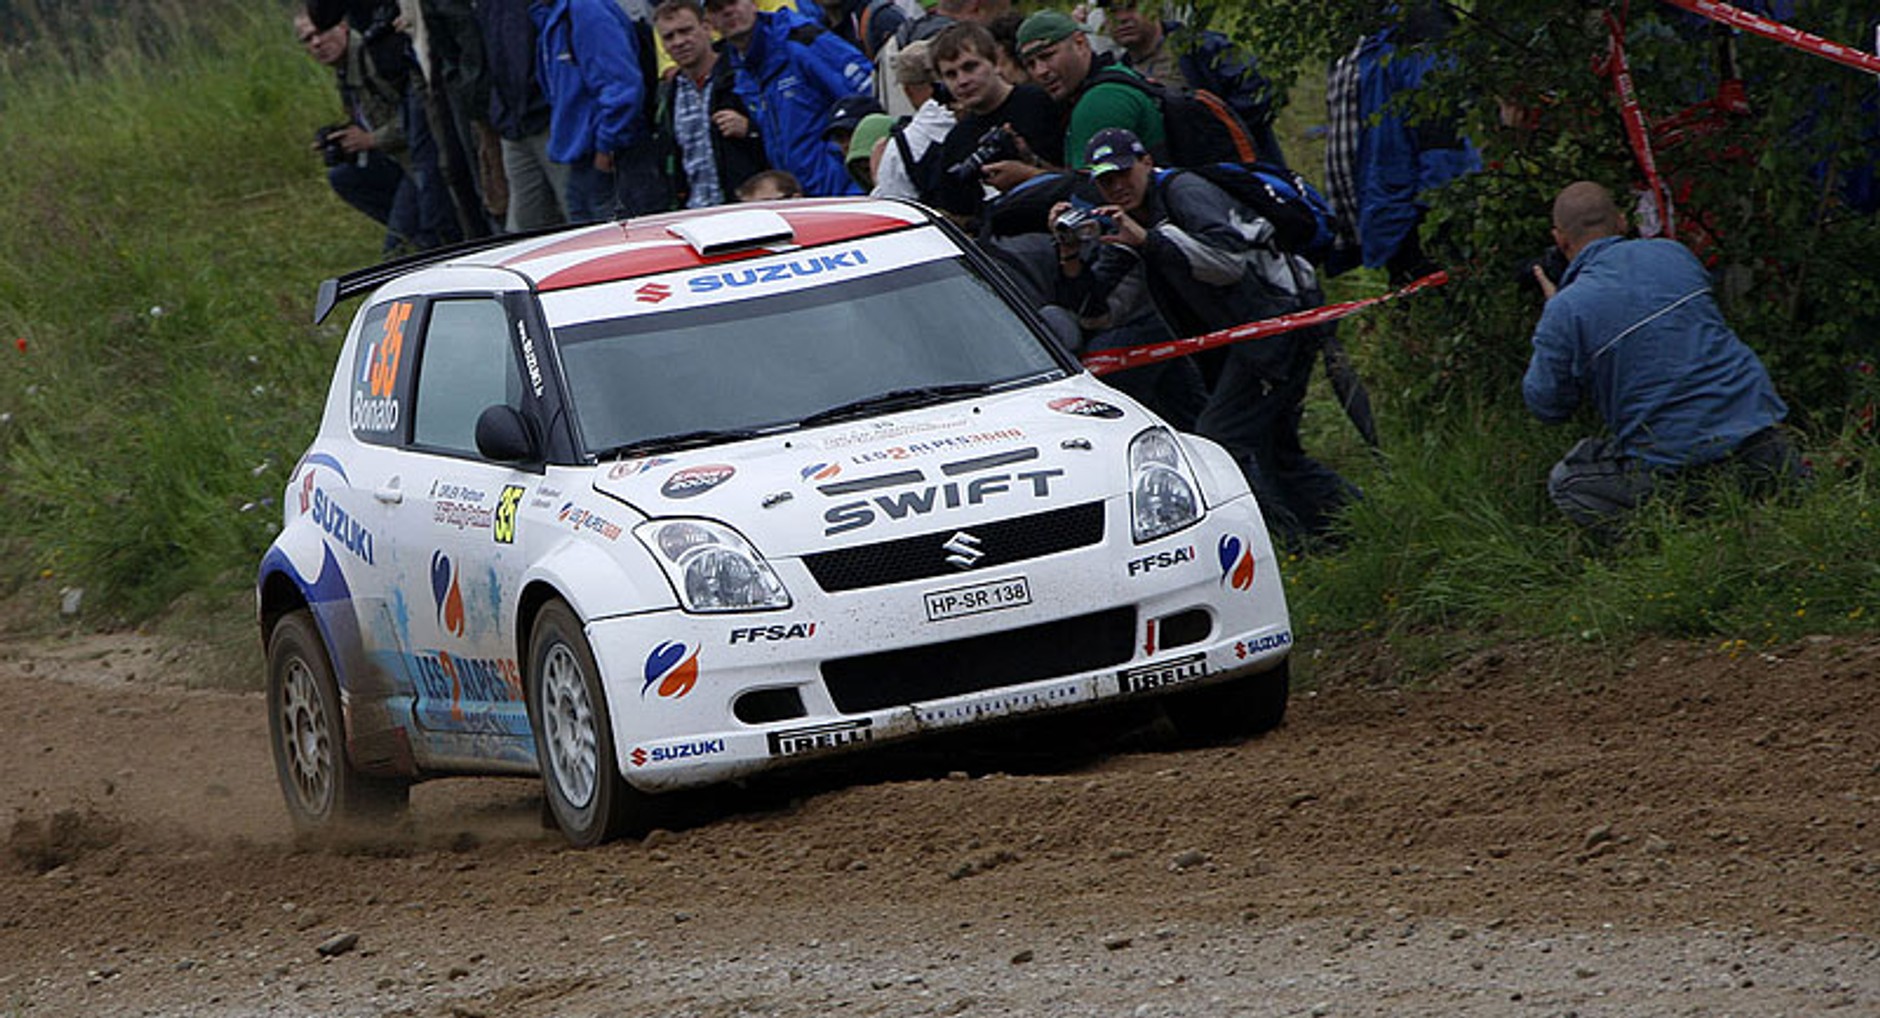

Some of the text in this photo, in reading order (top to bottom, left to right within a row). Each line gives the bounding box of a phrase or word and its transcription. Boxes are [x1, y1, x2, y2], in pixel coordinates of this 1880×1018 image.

[687, 249, 868, 293] SUZUKI
[371, 301, 413, 396] 35
[352, 390, 399, 431] Bonato
[495, 485, 524, 542] 35
[824, 467, 1065, 537] SWIFT
[313, 486, 373, 565] SUZUKI
[1128, 549, 1191, 577] FFSA
[930, 583, 1025, 614] HP-SR 138
[729, 623, 807, 645] FFSA
[1248, 630, 1291, 654] SUZUKI
[1117, 652, 1208, 692] PIRELLI
[650, 738, 725, 762] SUZUKI
[766, 717, 874, 756] PIRELLI
